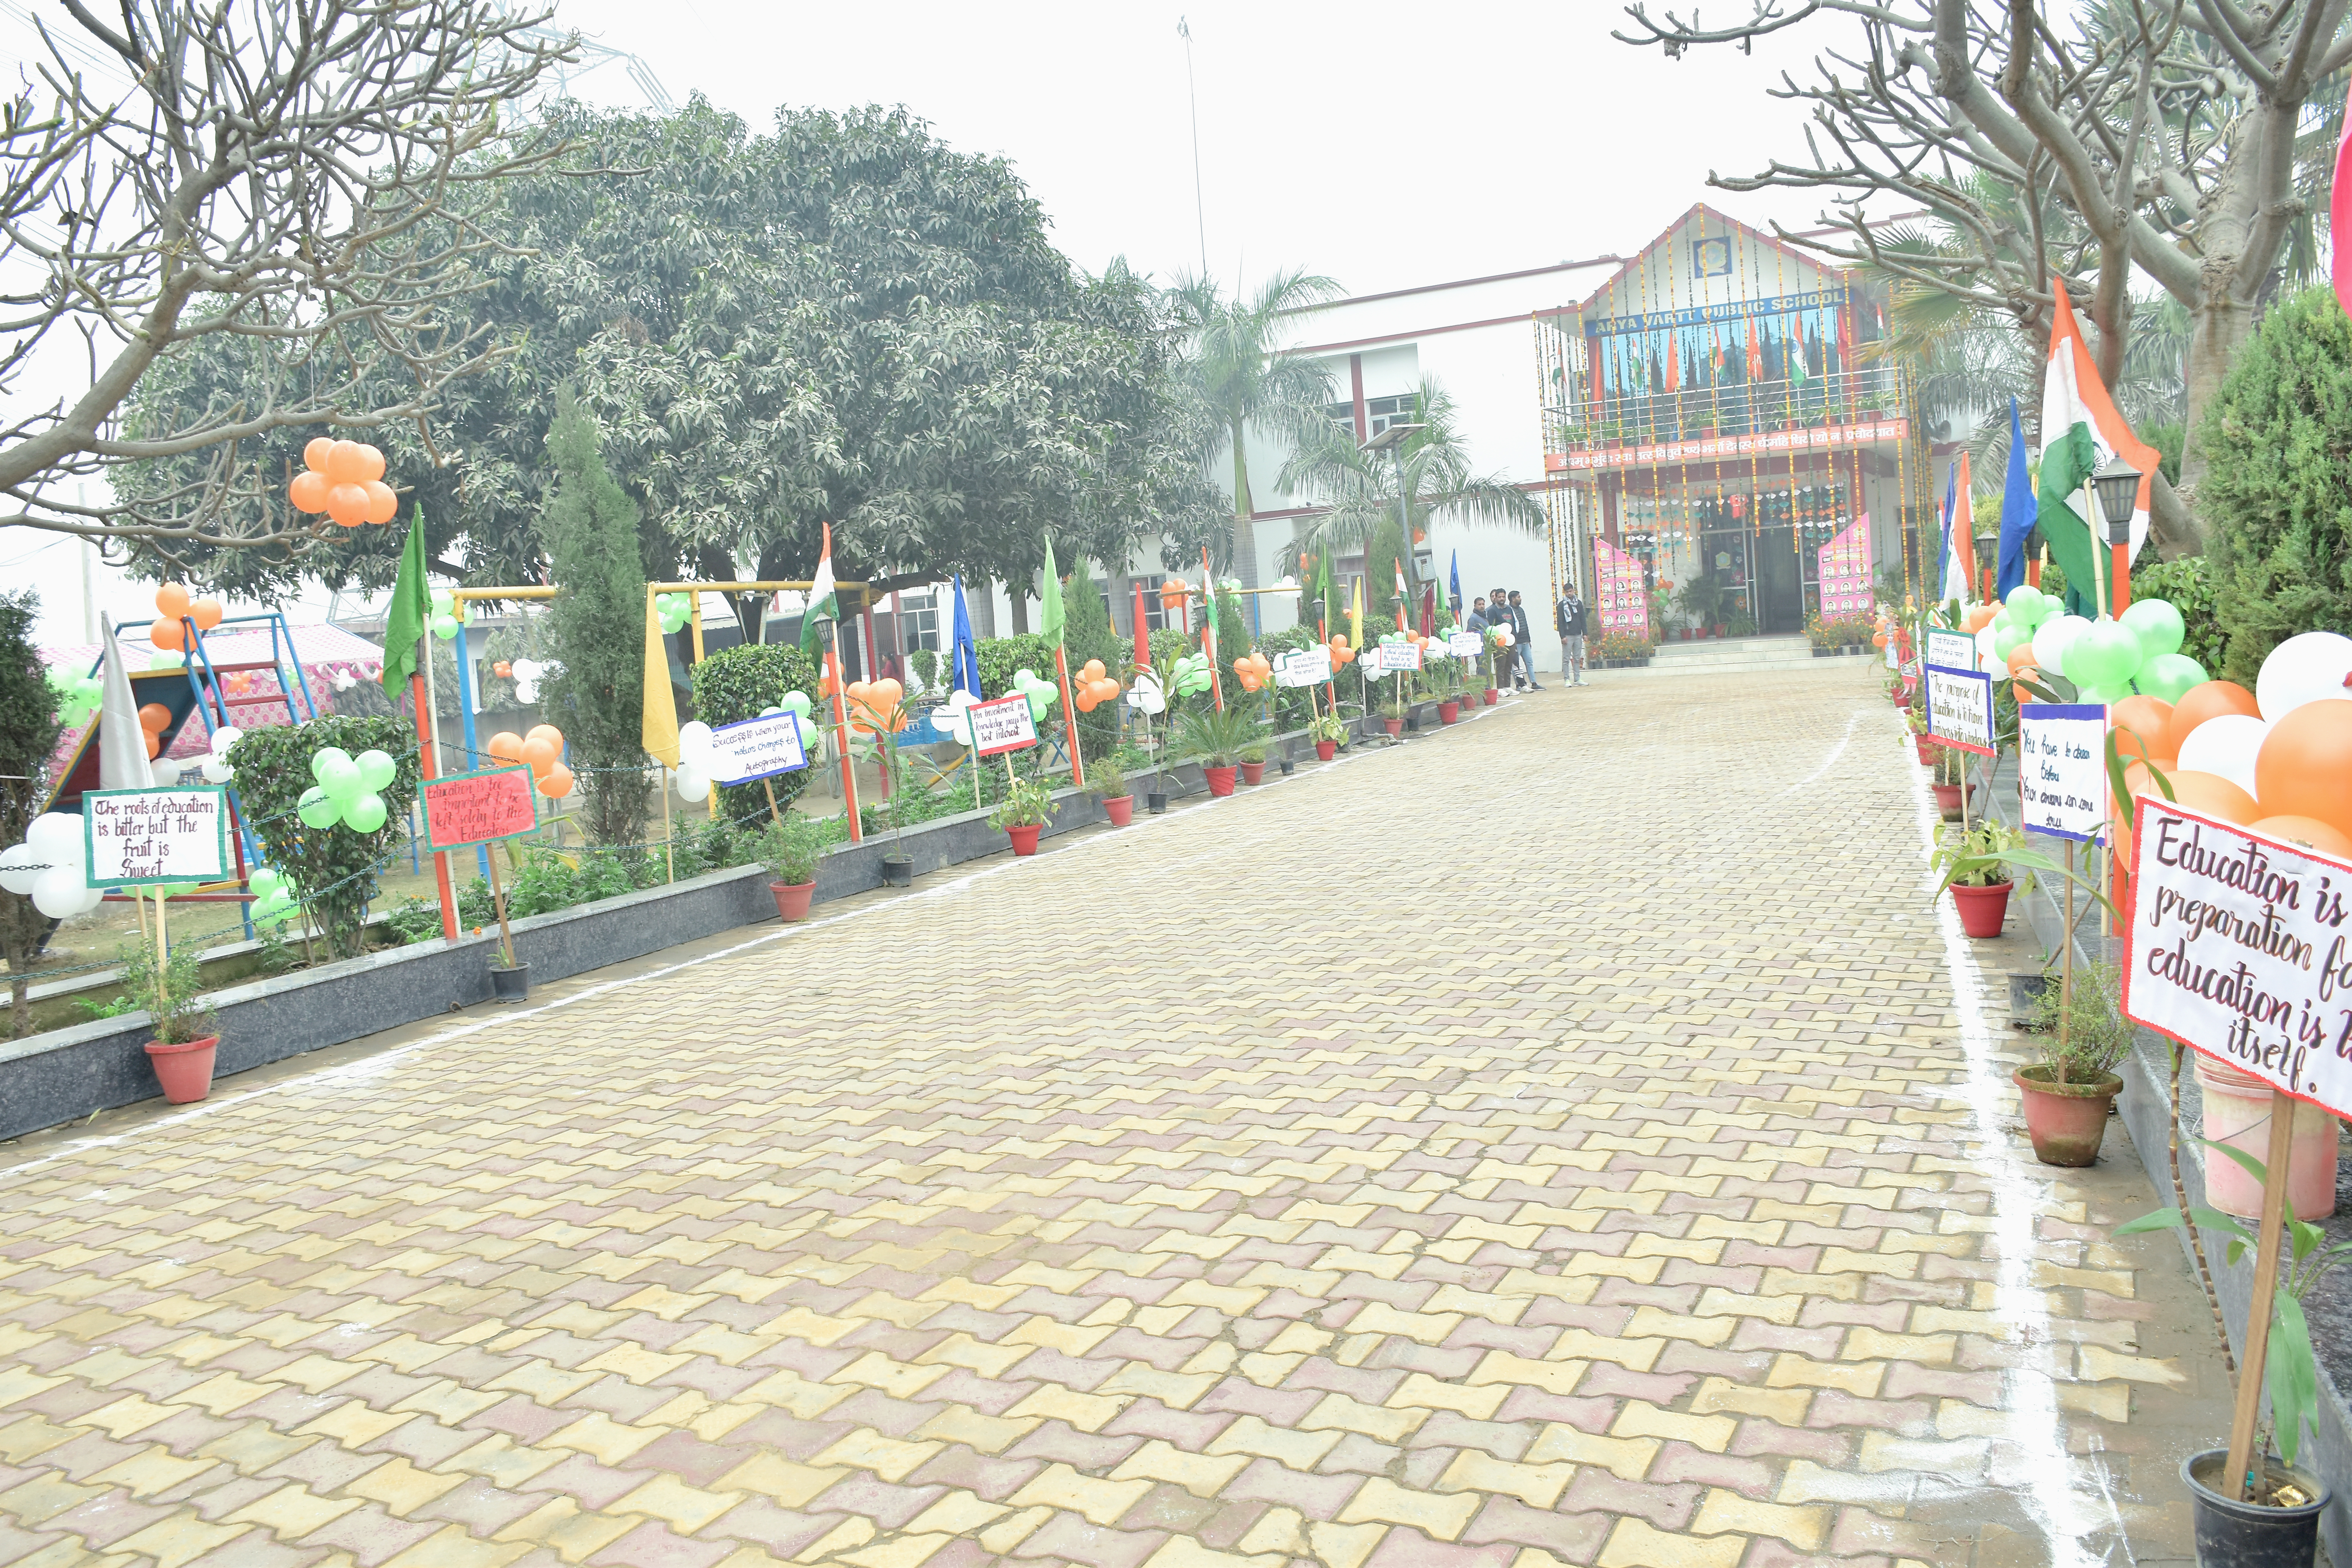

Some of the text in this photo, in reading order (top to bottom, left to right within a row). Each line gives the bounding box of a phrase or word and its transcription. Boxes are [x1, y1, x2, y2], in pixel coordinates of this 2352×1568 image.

[1595, 291, 1843, 333] ARYA VARTT PUBLIC SCHOOL
[1973, 684, 1980, 705] of
[984, 701, 1015, 717] investment
[1017, 702, 1024, 710] in
[1931, 697, 1955, 719] education
[975, 713, 1029, 731] knowledge pays the
[713, 732, 746, 748] Success
[773, 722, 791, 734] your
[785, 735, 795, 745] to
[981, 726, 1020, 742] best interest
[2022, 728, 2035, 754] You
[2041, 733, 2058, 757] have
[427, 777, 503, 799] Education is too
[95, 794, 214, 815] The roots of education
[443, 789, 521, 814] important to be
[98, 814, 198, 837] is bitter but the
[435, 805, 523, 829] left solely to the
[460, 822, 510, 842] Educators
[123, 835, 170, 857] fruit is
[2156, 816, 2349, 928] Education is
[2149, 885, 2352, 1002] preparation fo
[2147, 937, 2292, 1033] education
[2298, 998, 2327, 1049] is
